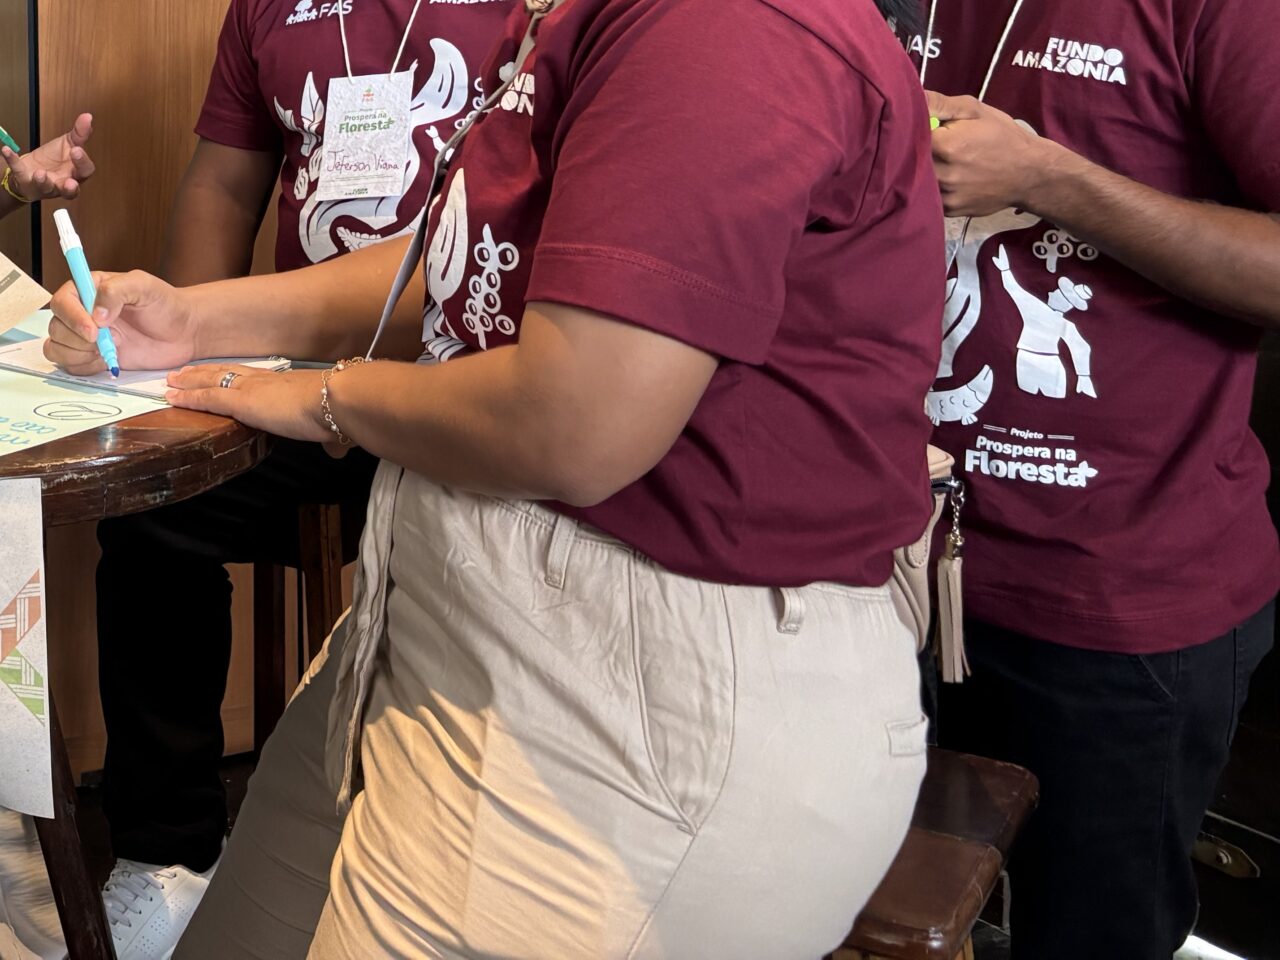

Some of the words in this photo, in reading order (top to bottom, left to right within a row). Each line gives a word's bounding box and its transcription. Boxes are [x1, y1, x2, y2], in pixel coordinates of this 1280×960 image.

[318, 0, 354, 19] FAS
[1046, 37, 1124, 67] FUNDO
[339, 119, 392, 134] Floresta
[344, 112, 377, 122] Prospera
[1010, 427, 1044, 440] Projeto
[975, 435, 1051, 459] Prospera
[1054, 447, 1077, 461] na
[964, 448, 1088, 488] Floresta
